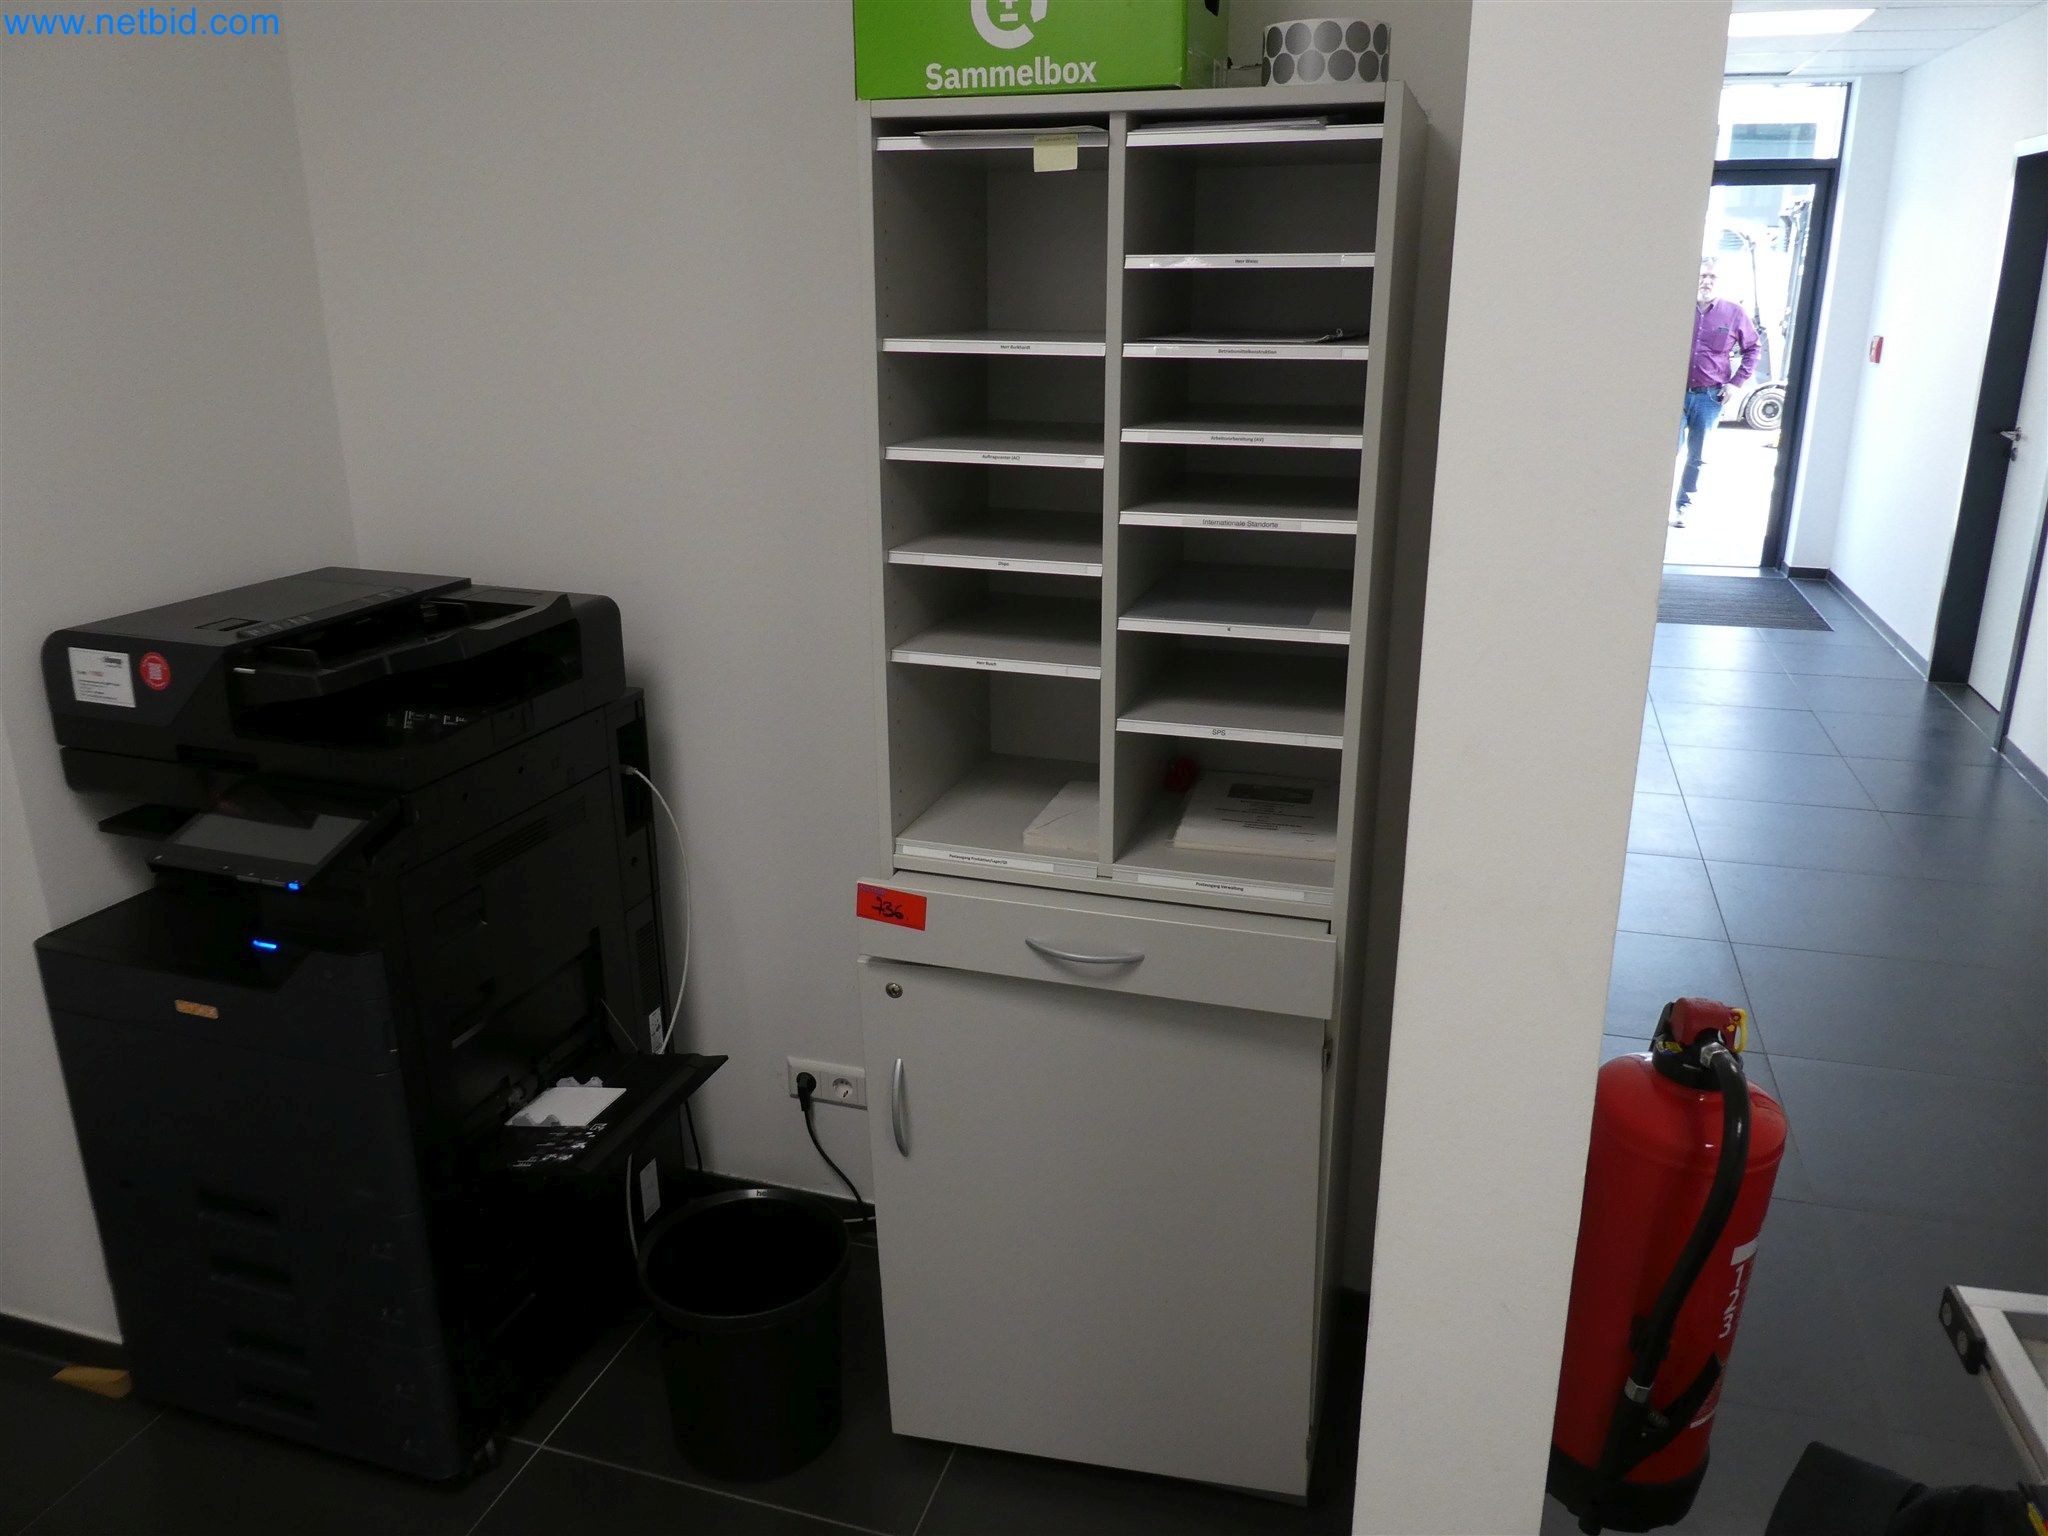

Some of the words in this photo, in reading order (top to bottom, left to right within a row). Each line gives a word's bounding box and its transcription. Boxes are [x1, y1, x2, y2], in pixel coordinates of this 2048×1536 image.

[925, 56, 1097, 90] Sammelbox
[1202, 518, 1246, 527] Internationale
[1247, 520, 1279, 528] Standorte
[1212, 728, 1226, 736] SPS
[1723, 1288, 1739, 1316] 2
[1718, 1312, 1734, 1339] 3
